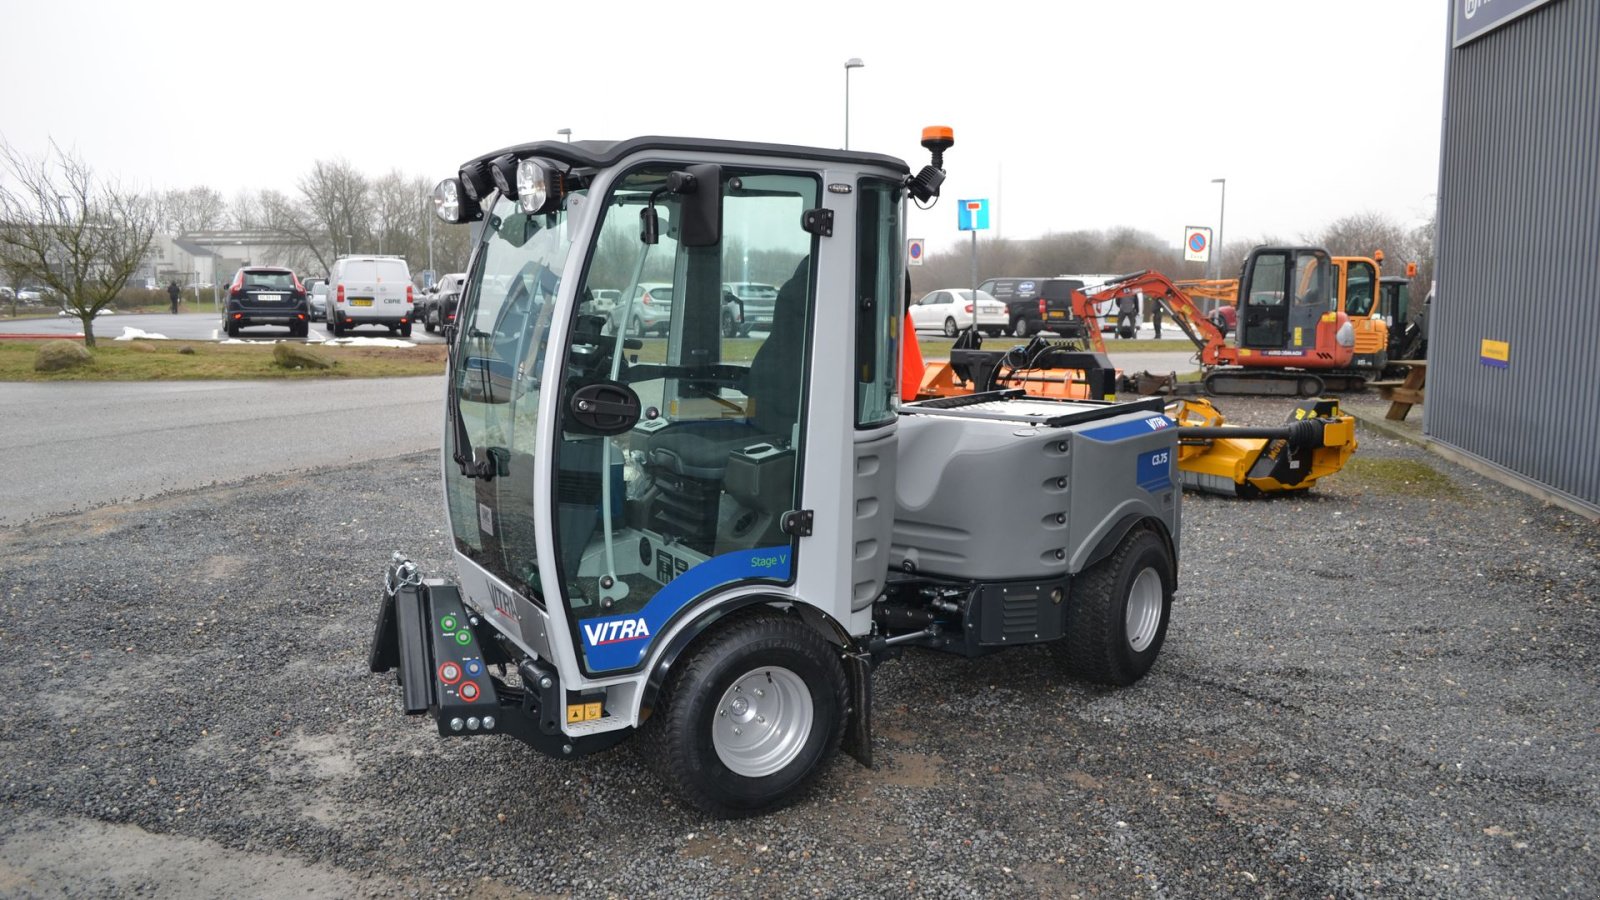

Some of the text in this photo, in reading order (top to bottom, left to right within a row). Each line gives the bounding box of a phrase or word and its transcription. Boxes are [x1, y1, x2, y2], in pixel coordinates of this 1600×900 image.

[1152, 452, 1168, 466] C3.75
[751, 553, 787, 568] Stage V
[485, 578, 519, 619] VITRA
[583, 617, 650, 646] VITRA
